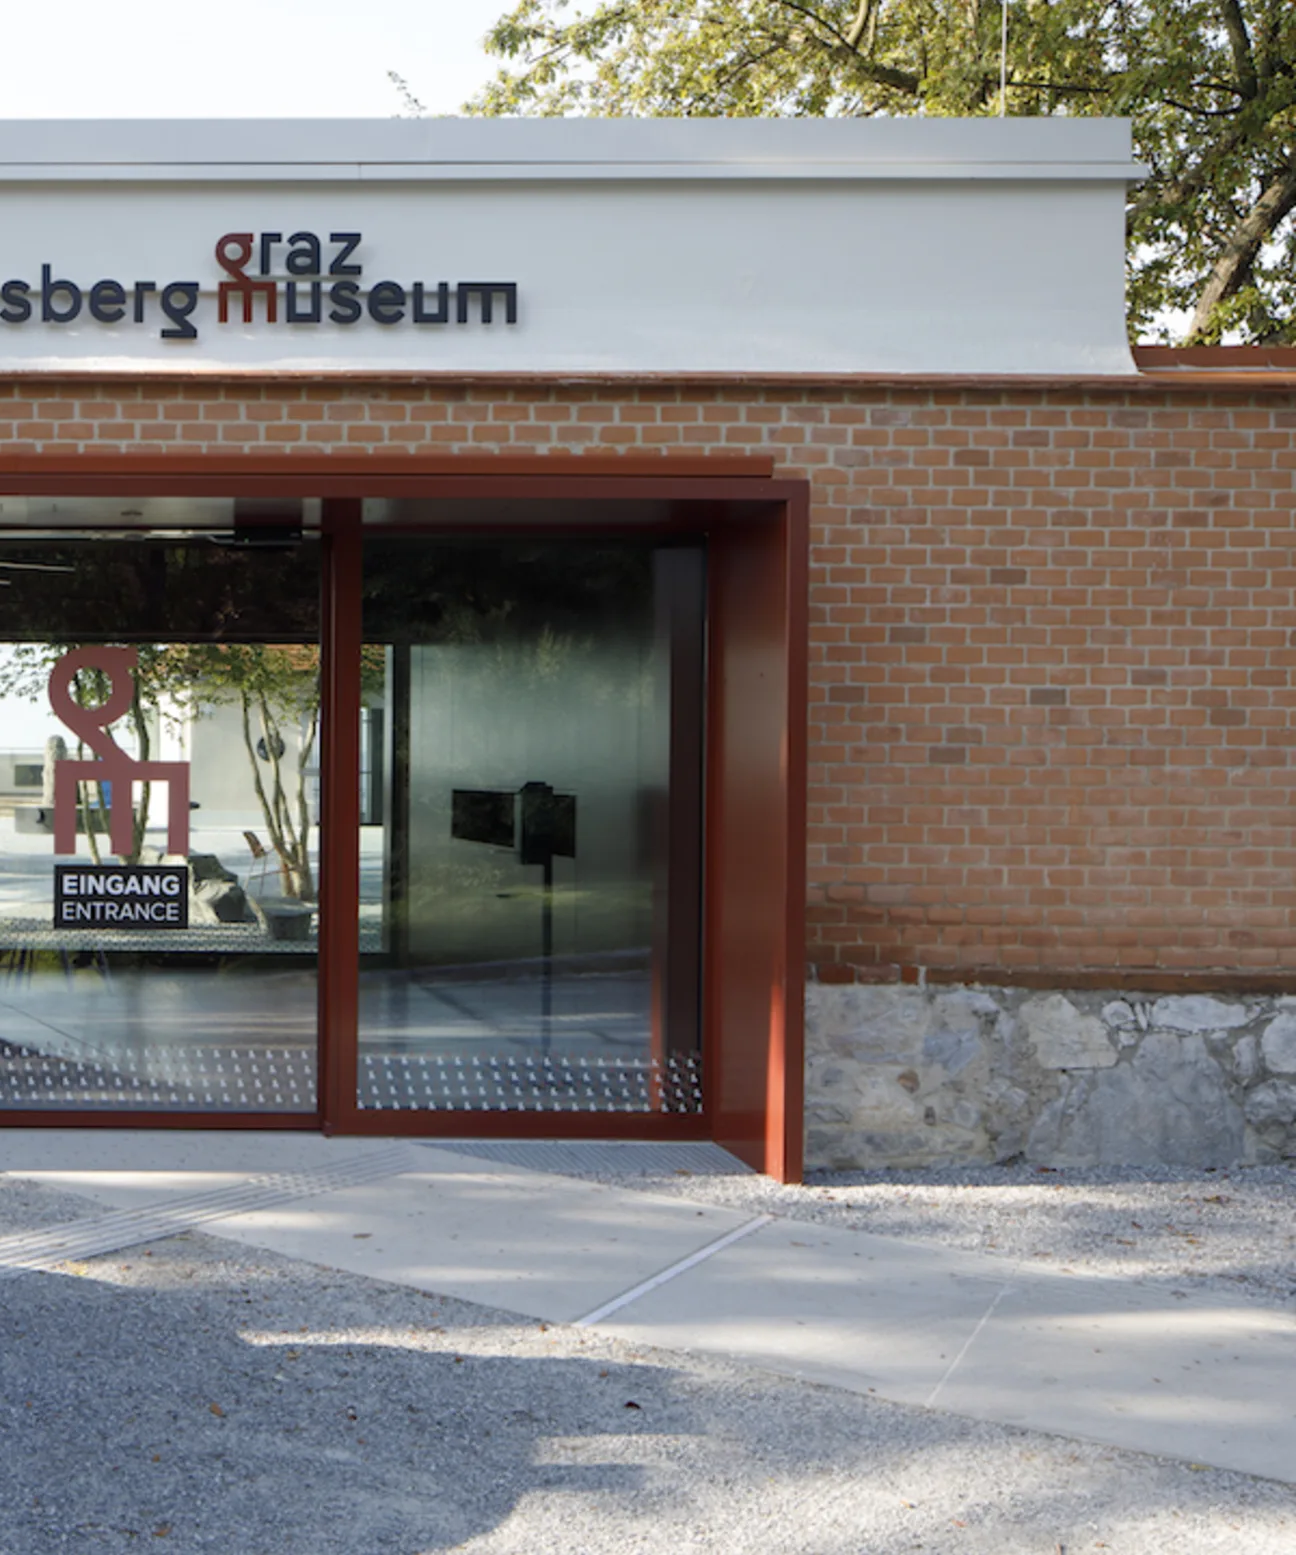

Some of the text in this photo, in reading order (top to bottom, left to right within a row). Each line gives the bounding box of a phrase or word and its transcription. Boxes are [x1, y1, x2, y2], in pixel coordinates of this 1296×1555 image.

[215, 232, 362, 278] graz
[215, 281, 518, 325] museum
[62, 874, 180, 896] EINGANG
[62, 901, 179, 922] ENTRANCE
